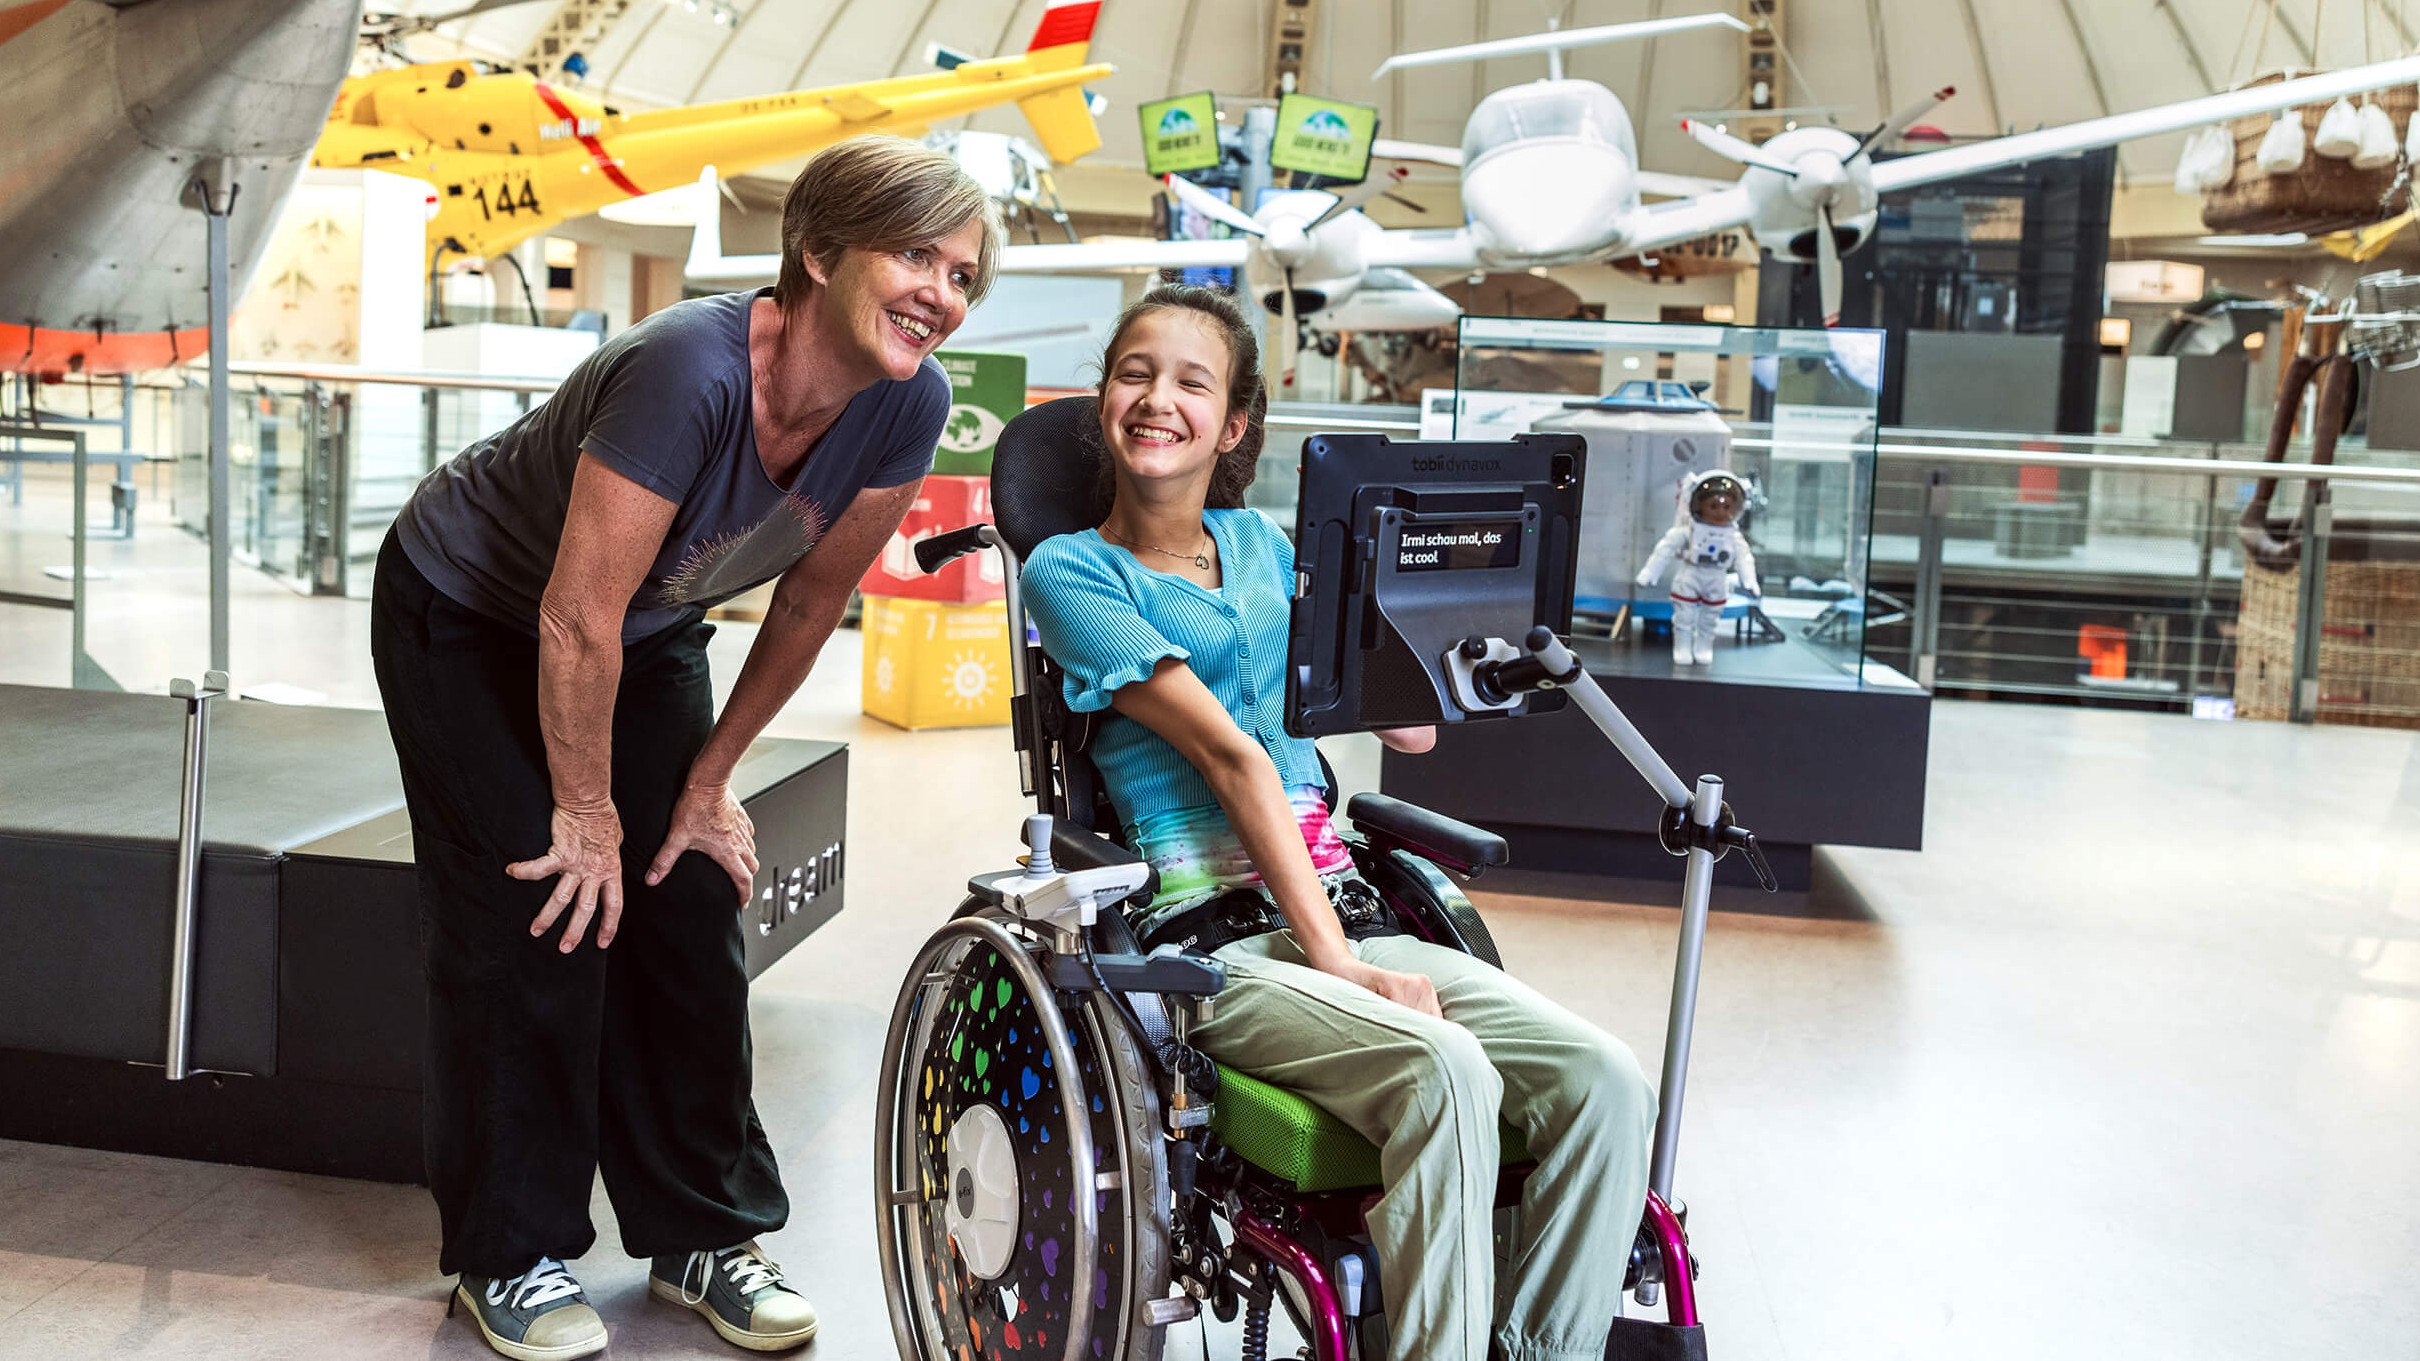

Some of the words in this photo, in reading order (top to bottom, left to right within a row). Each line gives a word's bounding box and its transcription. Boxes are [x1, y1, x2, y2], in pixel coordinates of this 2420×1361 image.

[473, 179, 541, 221] 144
[1412, 455, 1444, 472] tobii
[1445, 456, 1501, 473] dynavox
[1401, 533, 1425, 547] Irmi
[1427, 532, 1457, 546] schau
[1458, 531, 1482, 547] mal,
[1483, 531, 1501, 545] das
[1400, 551, 1414, 565] ist
[1415, 550, 1438, 564] cool
[759, 841, 844, 936] dream
